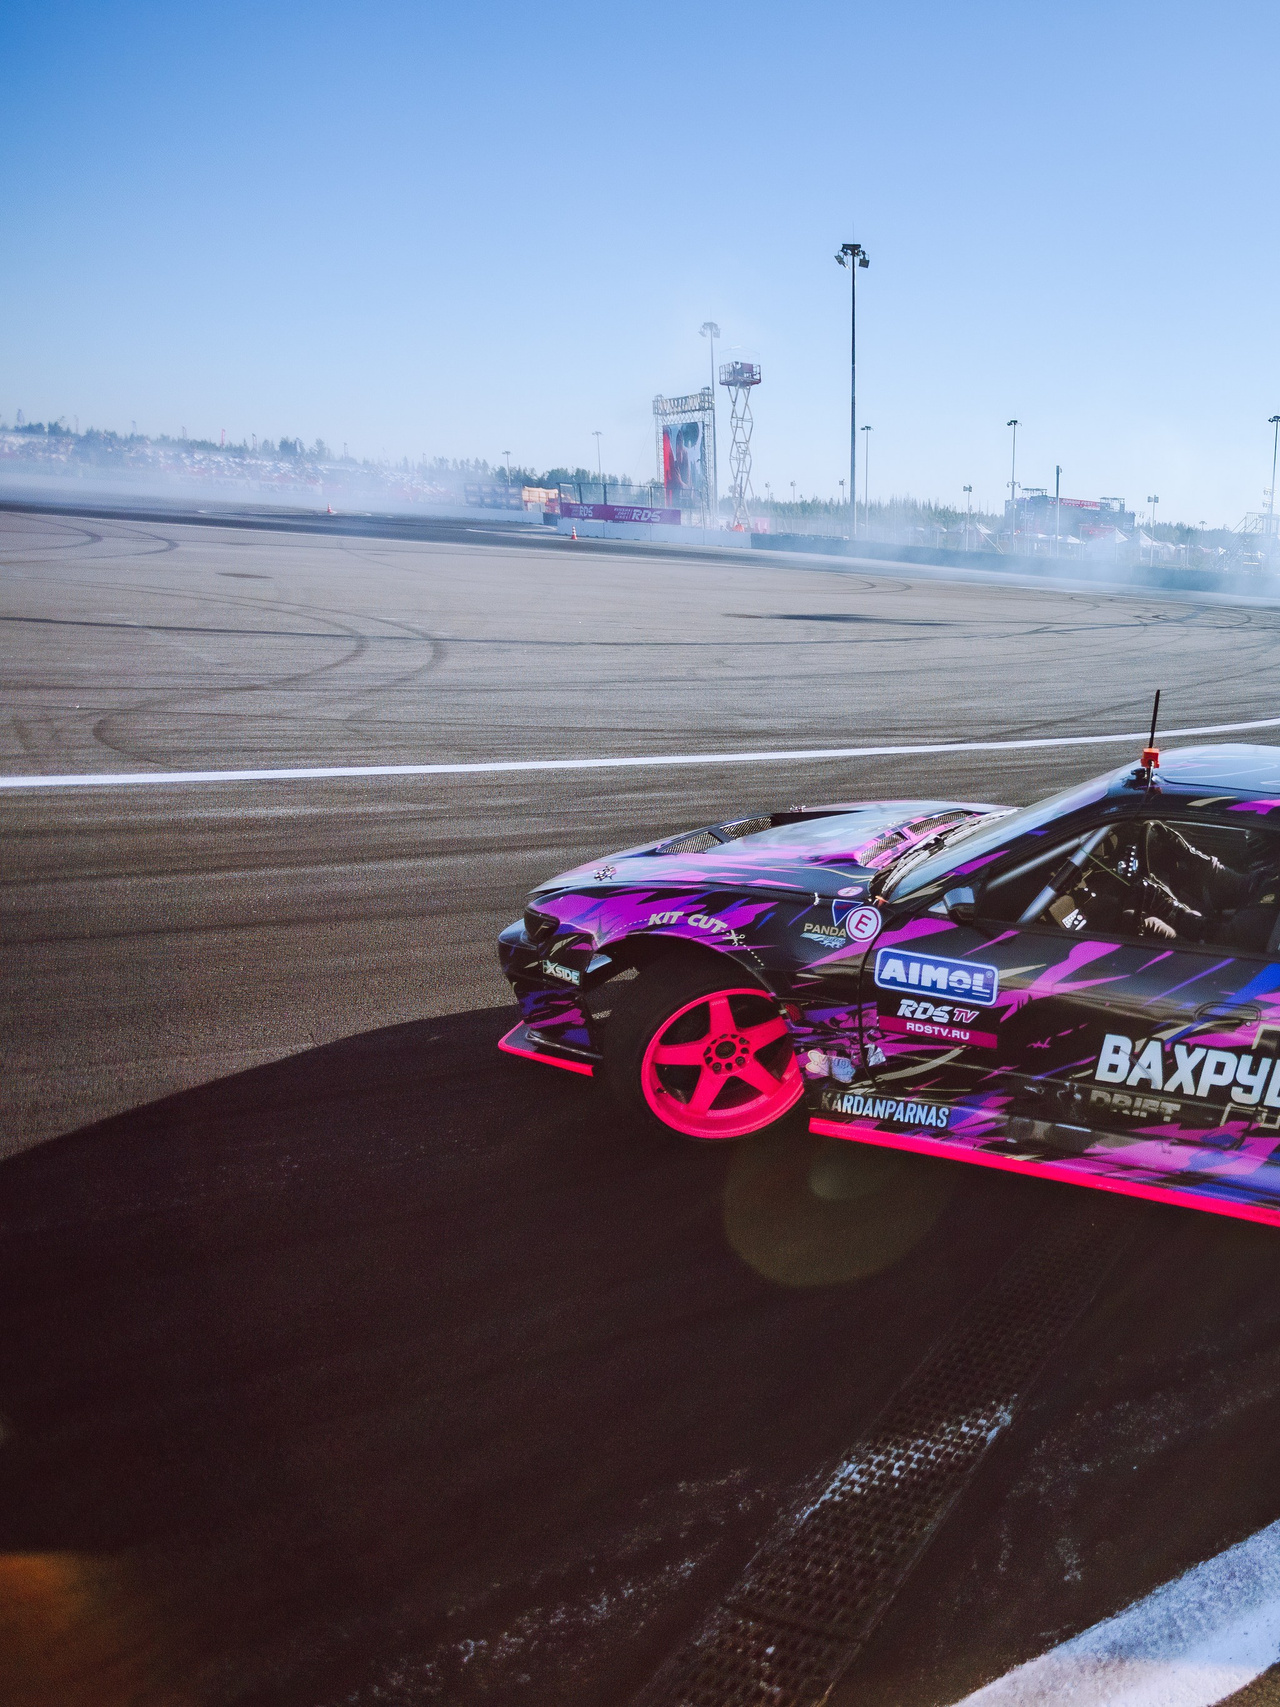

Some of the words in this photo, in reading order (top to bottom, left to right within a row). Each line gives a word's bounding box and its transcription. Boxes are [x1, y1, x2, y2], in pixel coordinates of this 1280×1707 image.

[632, 509, 662, 521] RDS
[648, 912, 684, 925] KIT
[687, 914, 728, 933] CUT
[803, 923, 847, 937] PANDA
[880, 958, 991, 997] AIMOL
[906, 1022, 970, 1040] RDSTV.RU
[1089, 1089, 1181, 1122] DRIFT
